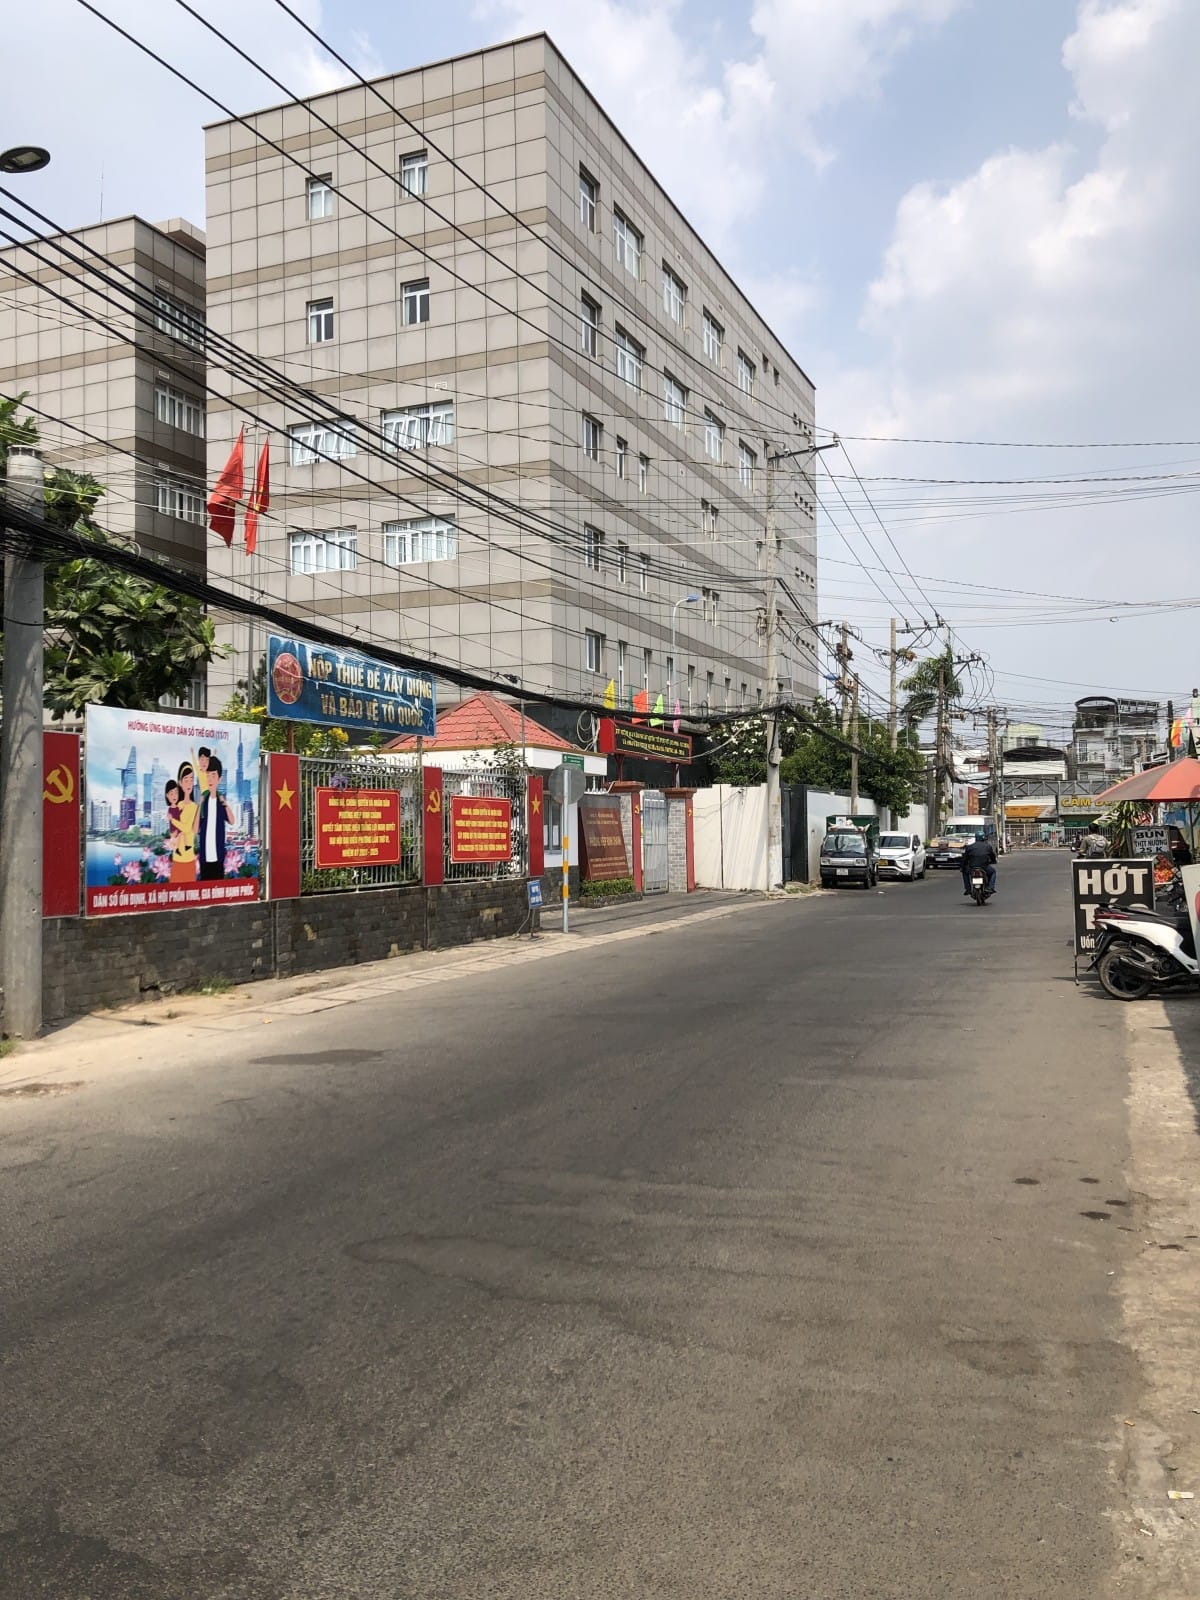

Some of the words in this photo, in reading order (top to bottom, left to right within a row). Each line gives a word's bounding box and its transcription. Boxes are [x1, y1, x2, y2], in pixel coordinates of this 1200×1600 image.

[336, 662, 364, 687] THUẾ
[384, 671, 404, 694] XÂY
[321, 691, 336, 716] VÀ
[340, 691, 362, 719] BẢO
[366, 698, 379, 725] VỆ
[1079, 863, 1148, 896] HỚT
